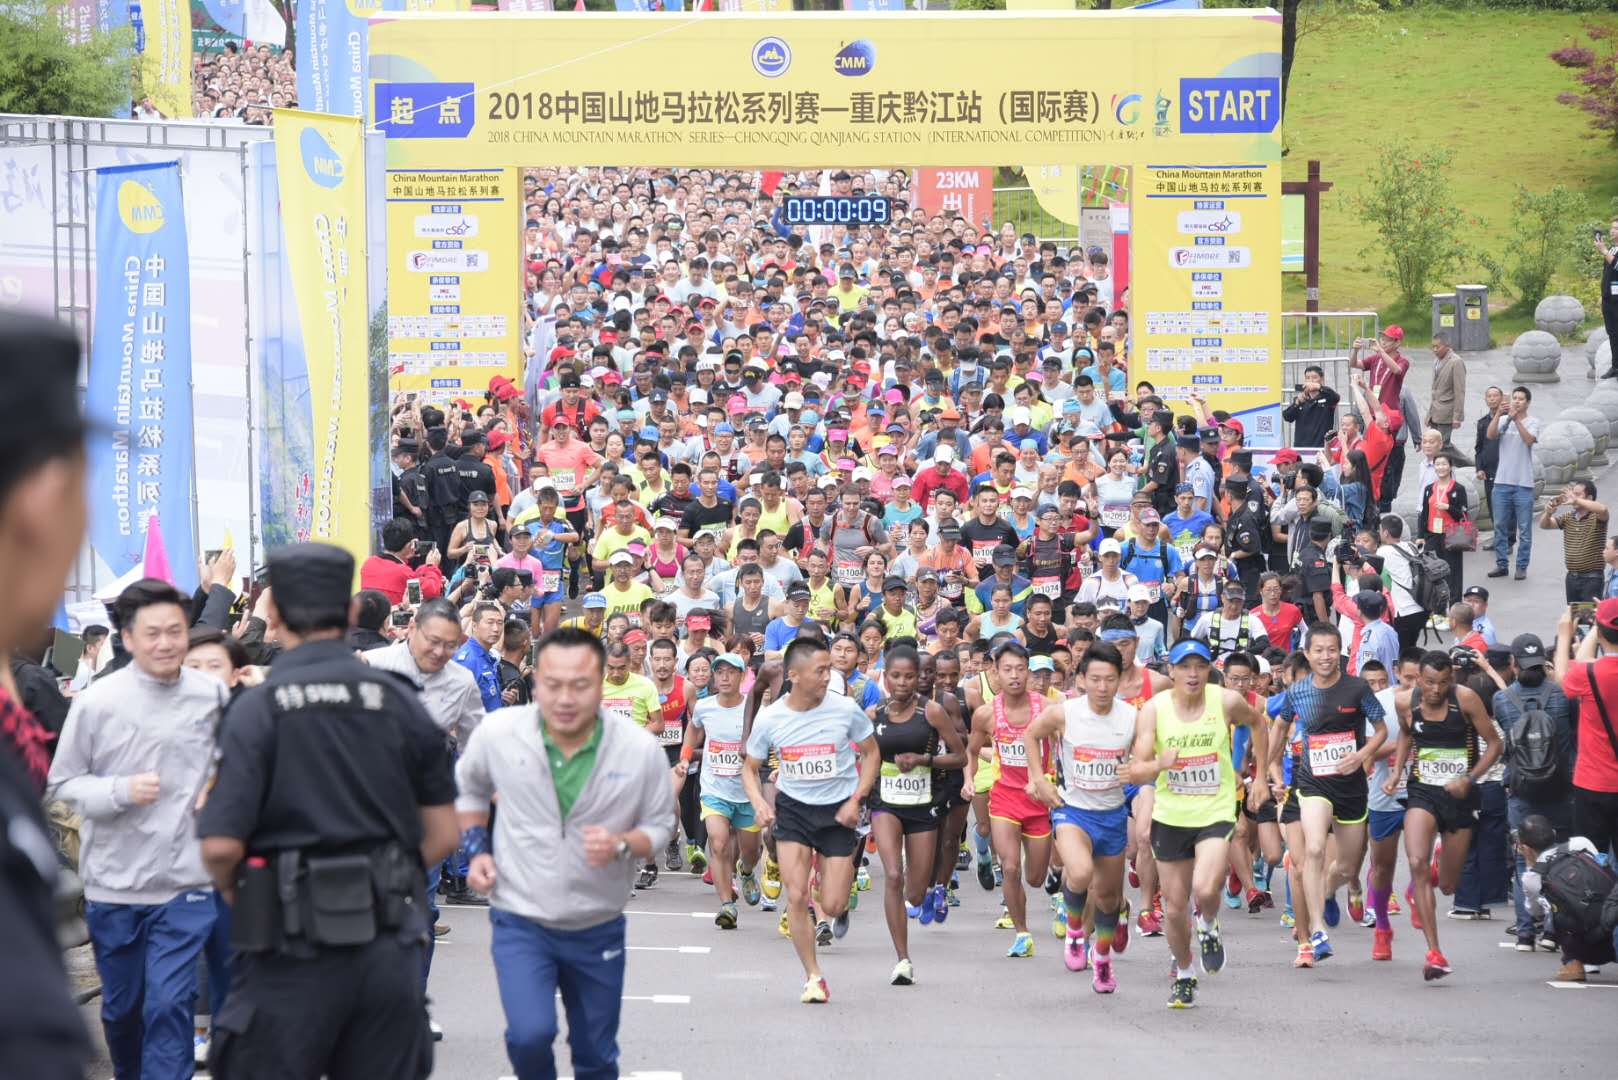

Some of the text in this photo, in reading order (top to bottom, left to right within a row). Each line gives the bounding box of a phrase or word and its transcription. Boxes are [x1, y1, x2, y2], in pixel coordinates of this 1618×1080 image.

[834, 56, 866, 69] CMM
[1188, 89, 1271, 122] START
[488, 131, 509, 143] 2018
[513, 131, 549, 143] CHINA
[552, 131, 615, 143] MOUNTAIN
[617, 131, 682, 143] MARATHON
[810, 131, 871, 146] QIANJIANG
[873, 131, 921, 143] STATION
[393, 173, 500, 183] China Mountain Marathon
[936, 171, 980, 189] 23KM
[1156, 169, 1262, 179] China Mountain Marathon
[393, 185, 499, 196] 中国山地马拉松系列赛
[1156, 182, 1262, 193] 中国山地马拉松系列赛
[787, 199, 887, 223] 00:00:09
[786, 759, 833, 776] M1063
[1168, 768, 1215, 783] M1101
